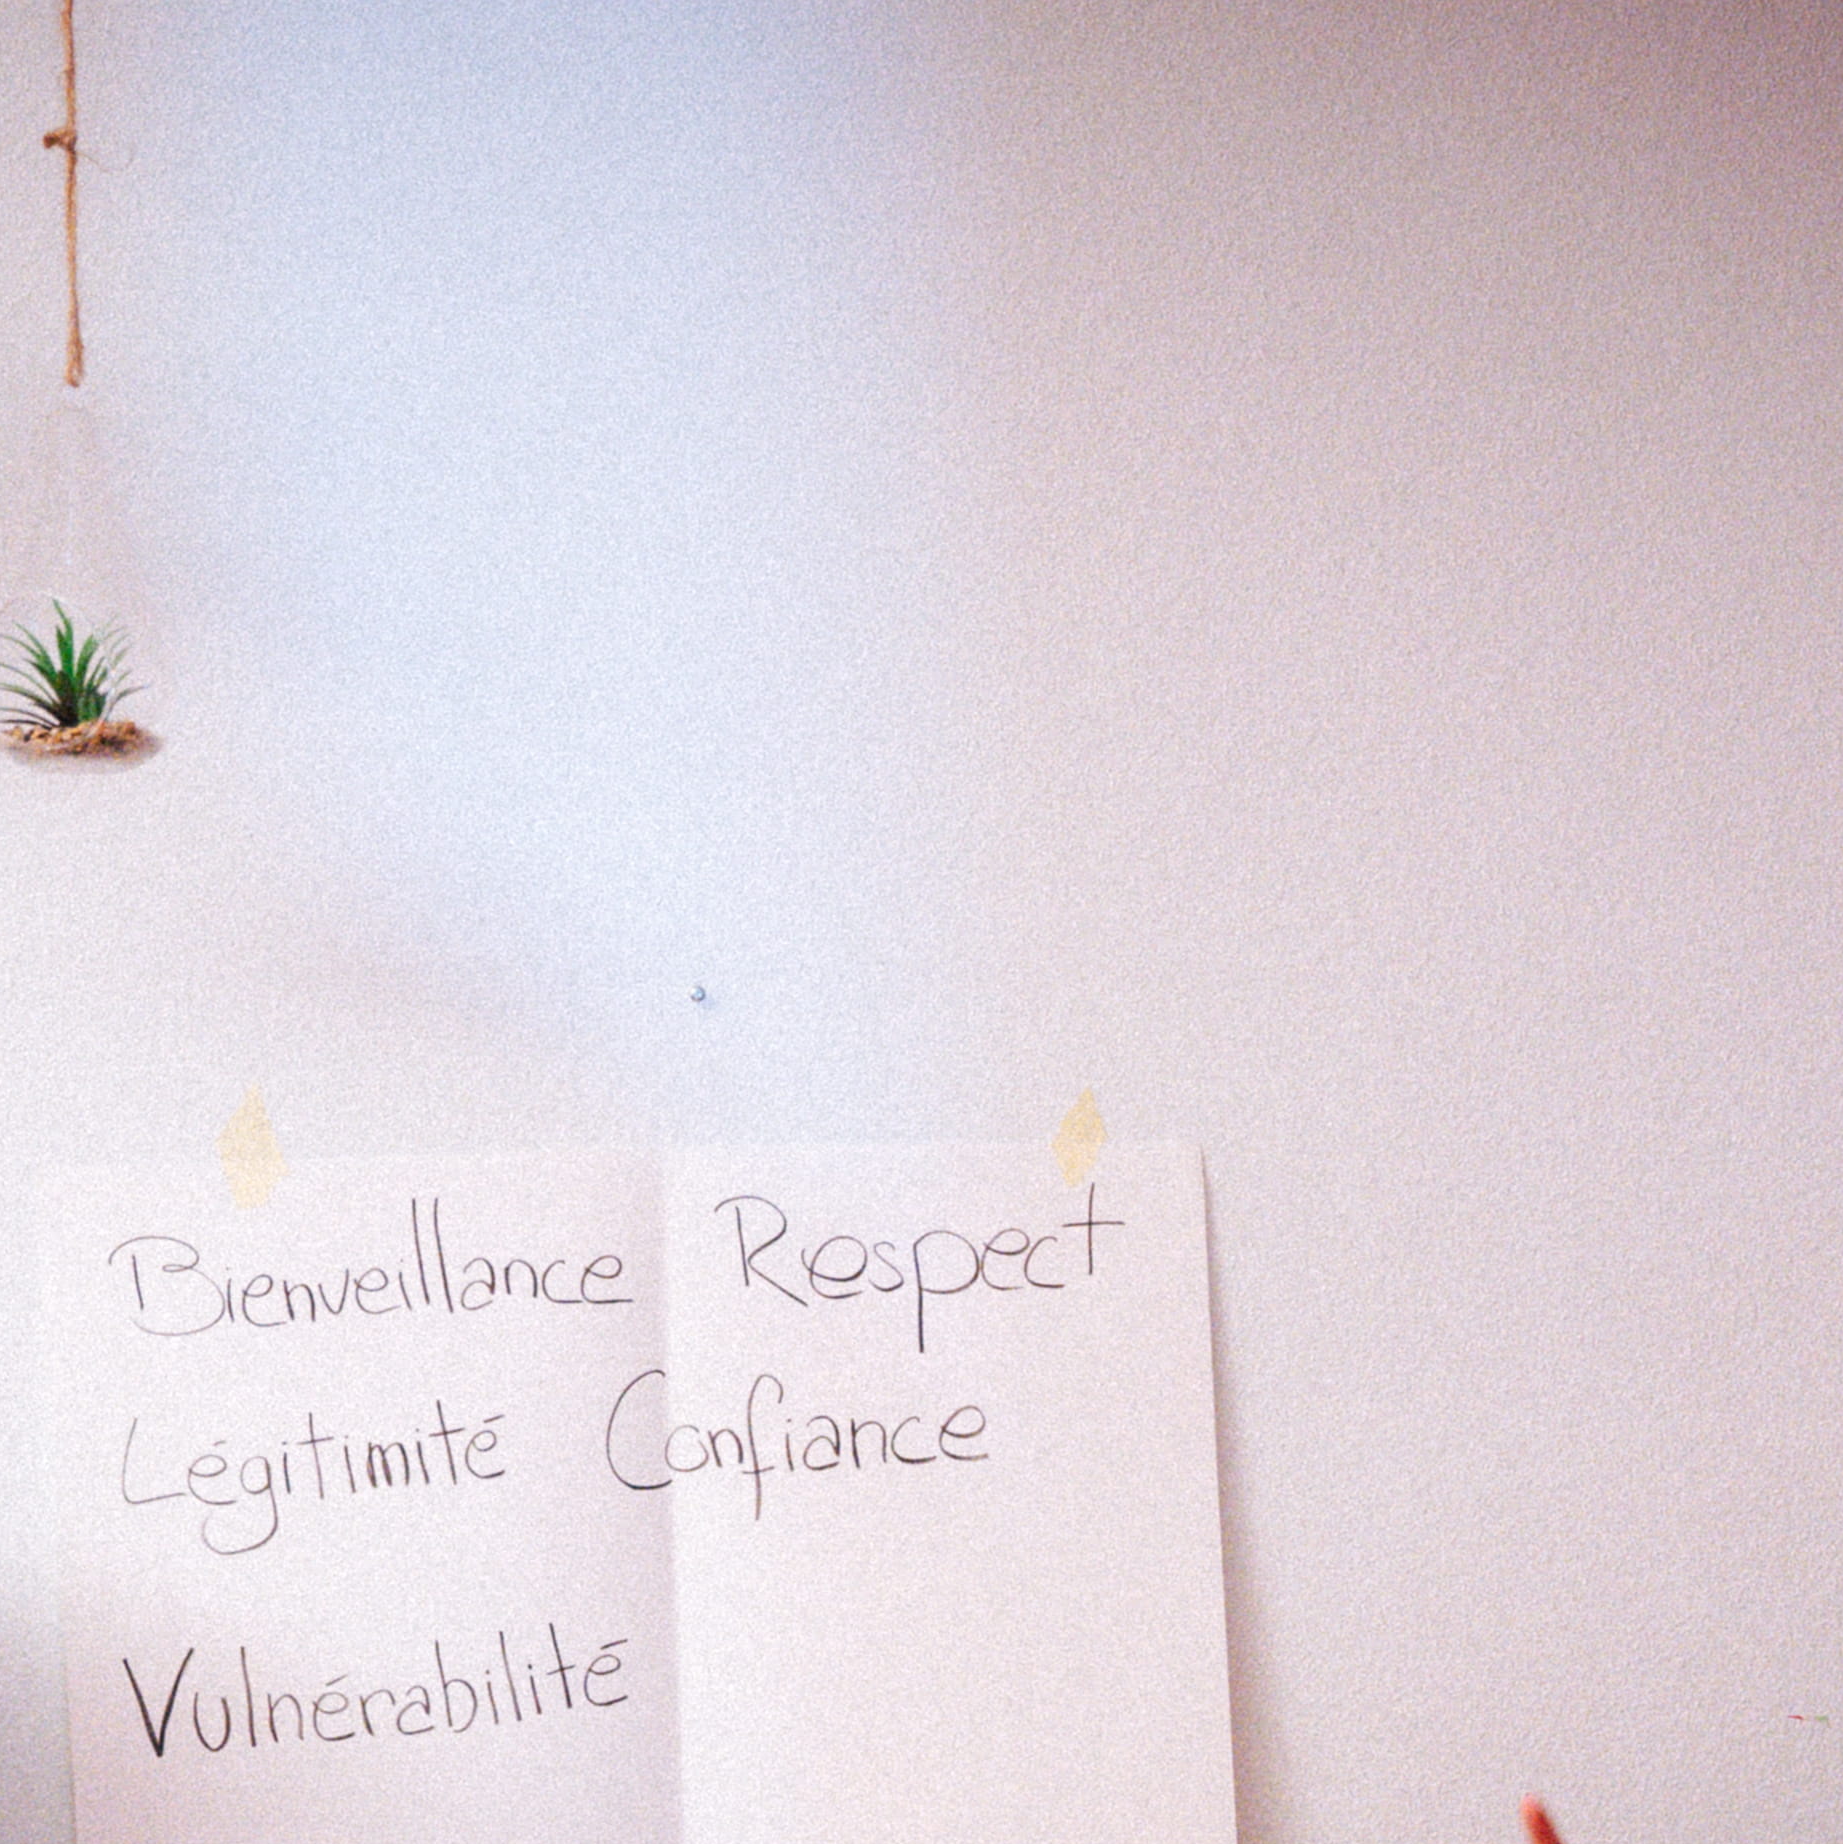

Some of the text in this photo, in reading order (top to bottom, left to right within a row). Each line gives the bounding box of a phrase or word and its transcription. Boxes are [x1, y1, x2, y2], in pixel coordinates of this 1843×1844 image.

[109, 1181, 1124, 1353] Bienveillance Respect
[121, 1369, 990, 1555] Légitimité Confiance
[121, 1621, 629, 1758] Vulnérabilité
